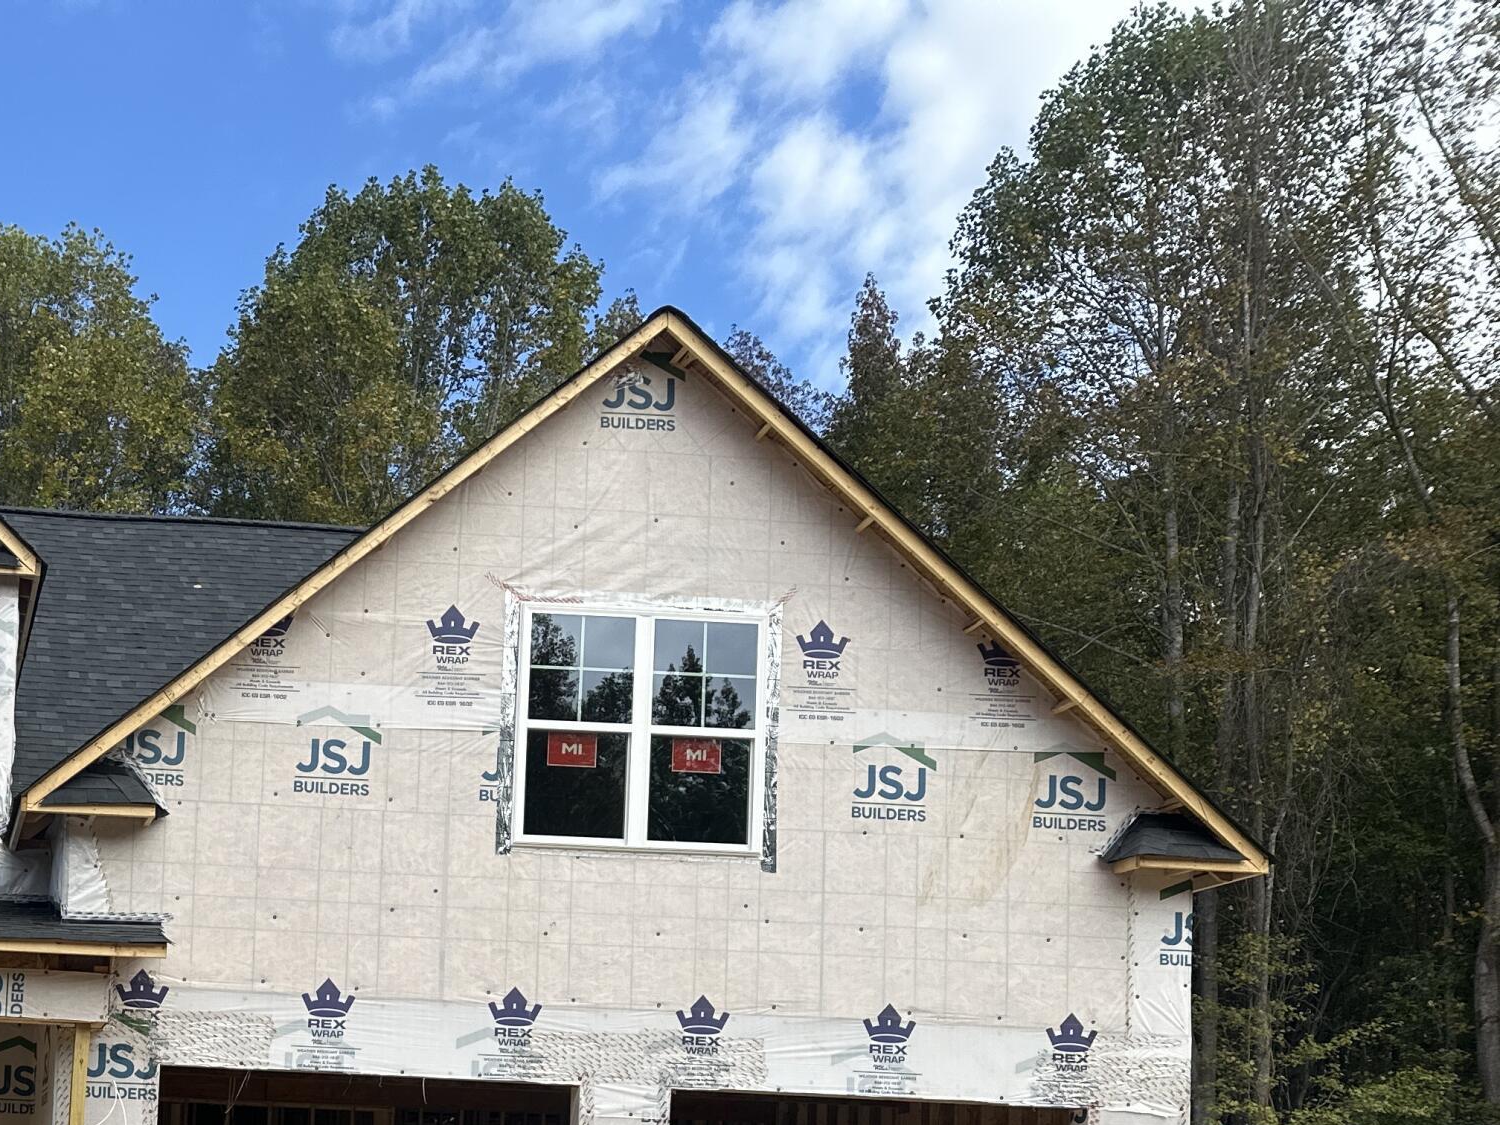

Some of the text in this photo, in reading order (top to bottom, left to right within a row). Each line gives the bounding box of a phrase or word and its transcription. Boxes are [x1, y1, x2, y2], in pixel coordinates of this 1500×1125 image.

[600, 416, 676, 432] BUILDERS
[250, 648, 284, 657] WRAP
[432, 645, 471, 656] REX
[436, 656, 469, 664] WRAP
[803, 659, 841, 671] REX
[806, 671, 839, 679] WRAP
[983, 668, 1020, 678] REX
[987, 678, 1020, 687] WRAP
[561, 742, 583, 755] MI
[295, 738, 371, 776] JSJ
[685, 749, 707, 762] MI
[293, 780, 370, 796] BUILDERS
[852, 764, 927, 802] JSJ
[1034, 775, 1107, 812] JSJ
[851, 806, 926, 822] BUILDERS
[1032, 816, 1106, 832] BUILDERS
[307, 1018, 347, 1030] REX
[311, 1029, 344, 1039] WRAP
[494, 1027, 533, 1039] REX
[498, 1038, 531, 1047] WRAP
[682, 1036, 721, 1047] REX
[869, 1044, 908, 1055] REX
[872, 1055, 906, 1064] WRAP
[1052, 1053, 1089, 1064] REX
[84, 1085, 158, 1101] BUILDERS
